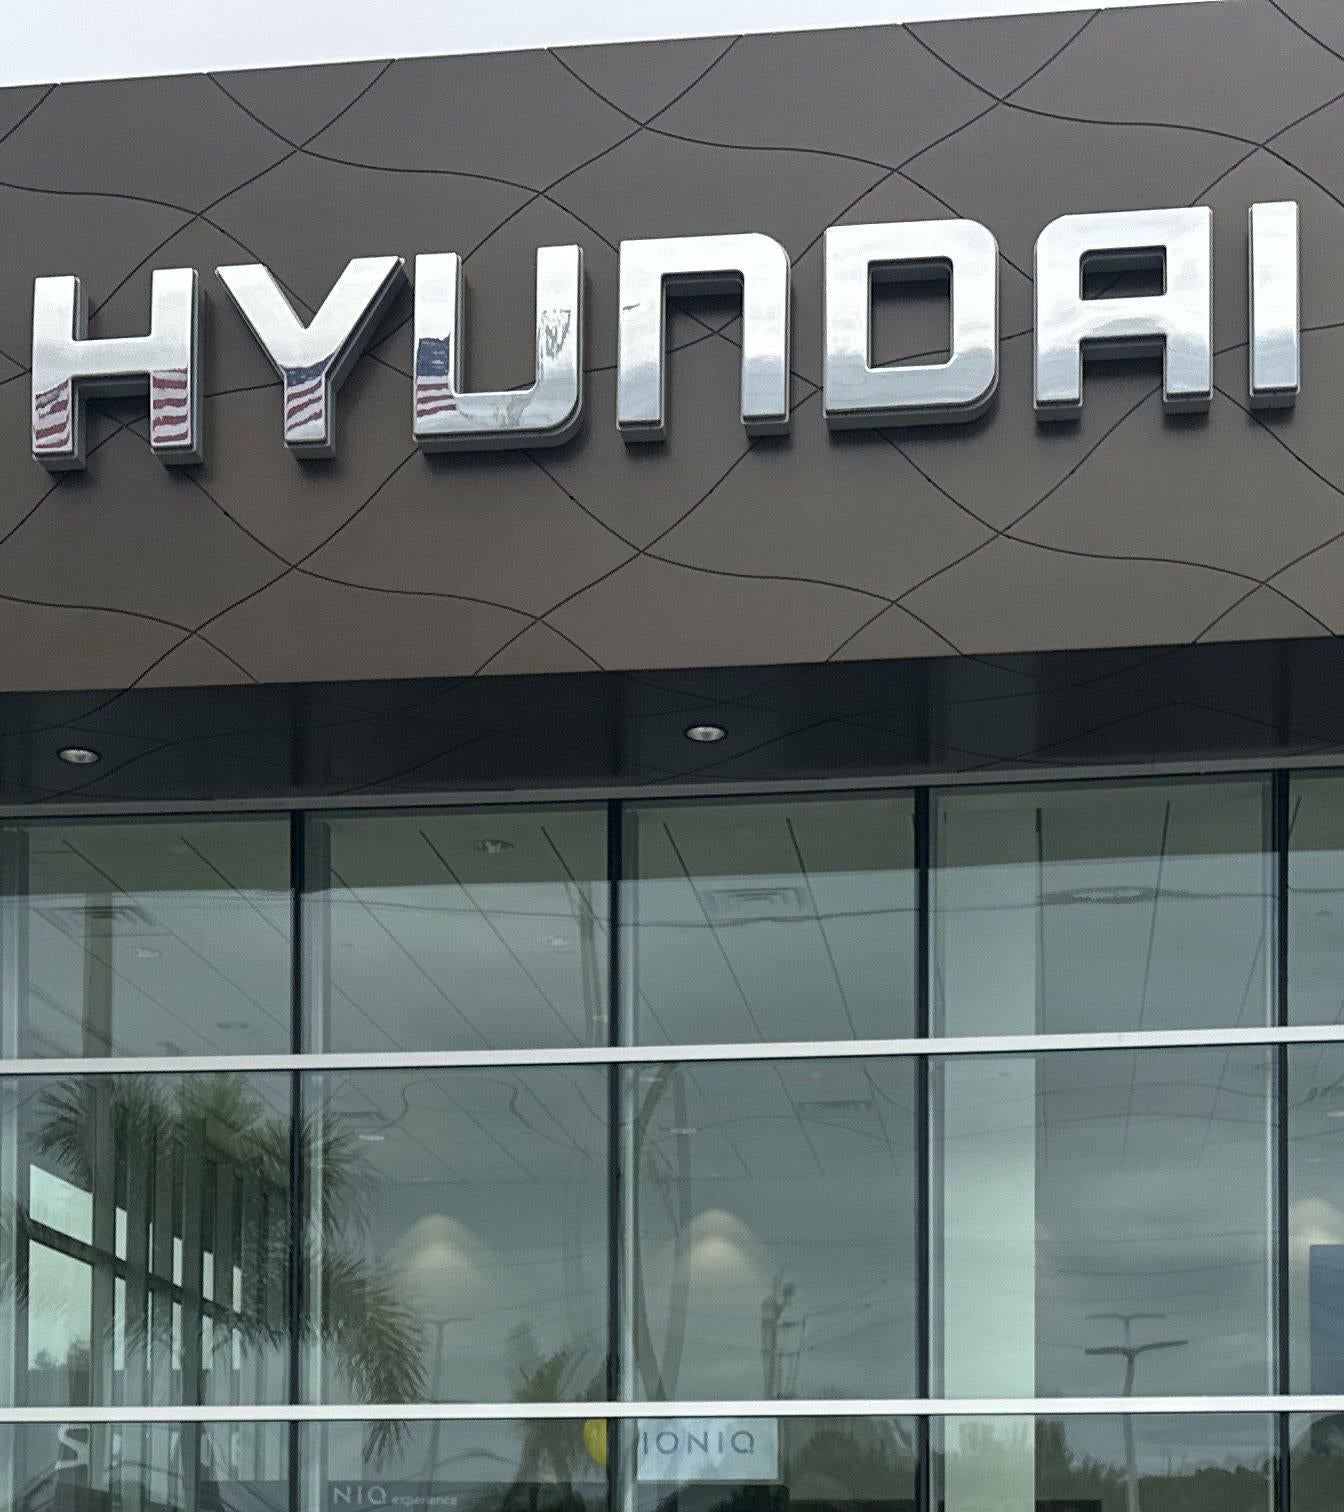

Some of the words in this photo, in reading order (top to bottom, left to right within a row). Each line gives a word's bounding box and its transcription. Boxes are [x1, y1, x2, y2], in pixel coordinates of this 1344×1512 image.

[30, 200, 1302, 471] HYUNDAI
[642, 1431, 754, 1454] IONIQ
[333, 1485, 387, 1505] NIQ
[391, 1494, 458, 1508] experience
